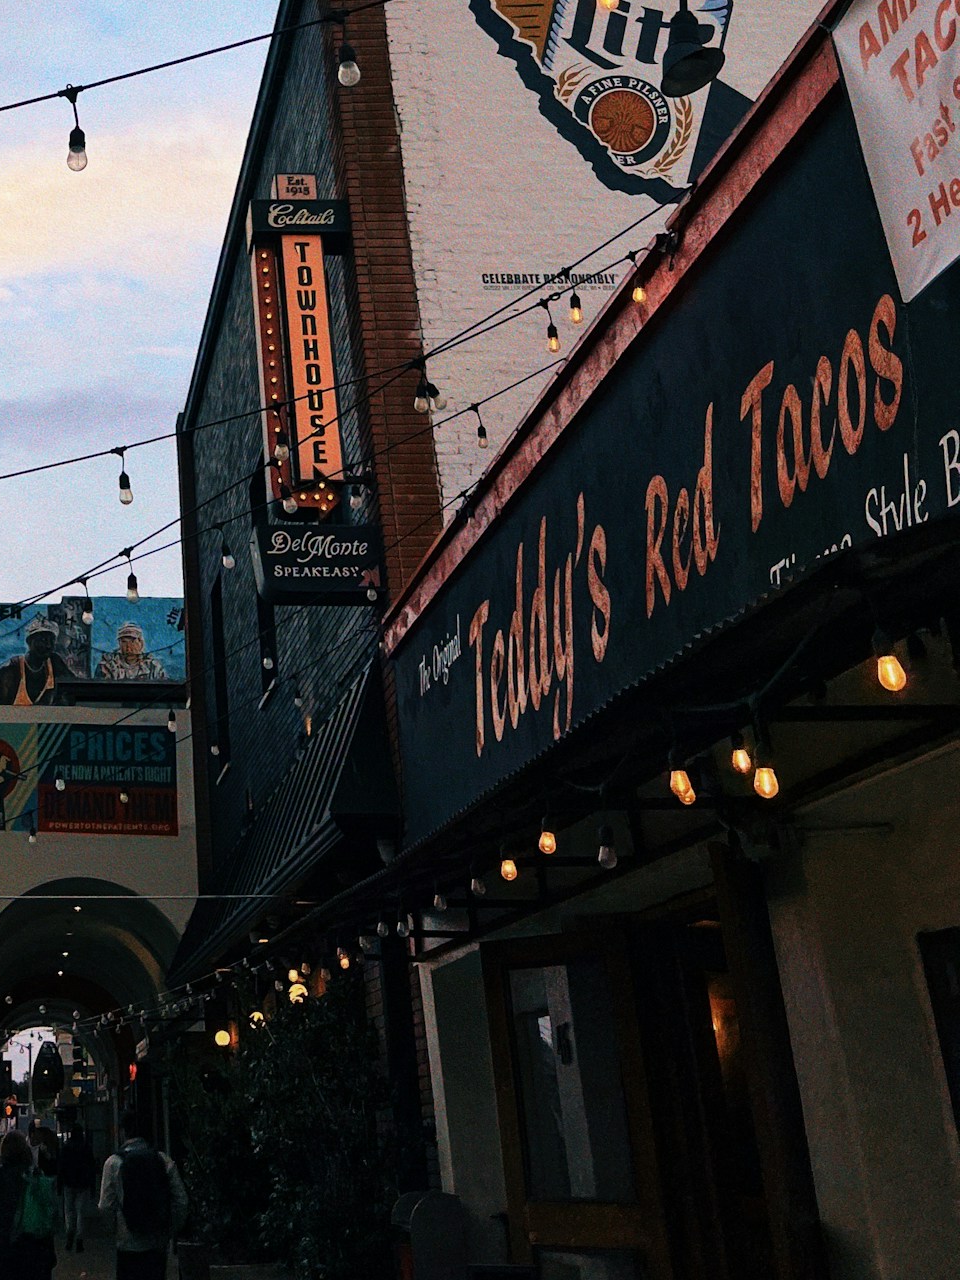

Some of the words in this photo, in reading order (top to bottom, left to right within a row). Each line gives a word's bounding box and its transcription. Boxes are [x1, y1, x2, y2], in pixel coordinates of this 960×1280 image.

[581, 90, 593, 105] A
[590, 78, 623, 97] FINE
[628, 78, 669, 125] PILSNER
[910, 100, 956, 178] Fast
[287, 176, 307, 185] Est.
[268, 203, 335, 228] Cocktails
[907, 208, 926, 249] 2
[482, 273, 540, 284] CELEBRATE
[295, 242, 328, 465] TOWNHOUSE
[469, 492, 612, 757] Teddy's
[645, 403, 721, 619] Red
[740, 293, 904, 533] Tacos
[267, 531, 312, 554] Del
[297, 535, 368, 562] Monte
[274, 564, 359, 577] SPEAKEASY
[419, 654, 431, 697] The
[433, 614, 462, 686] Original
[70, 730, 166, 762] PRICES
[71, 765, 92, 781] NOW
